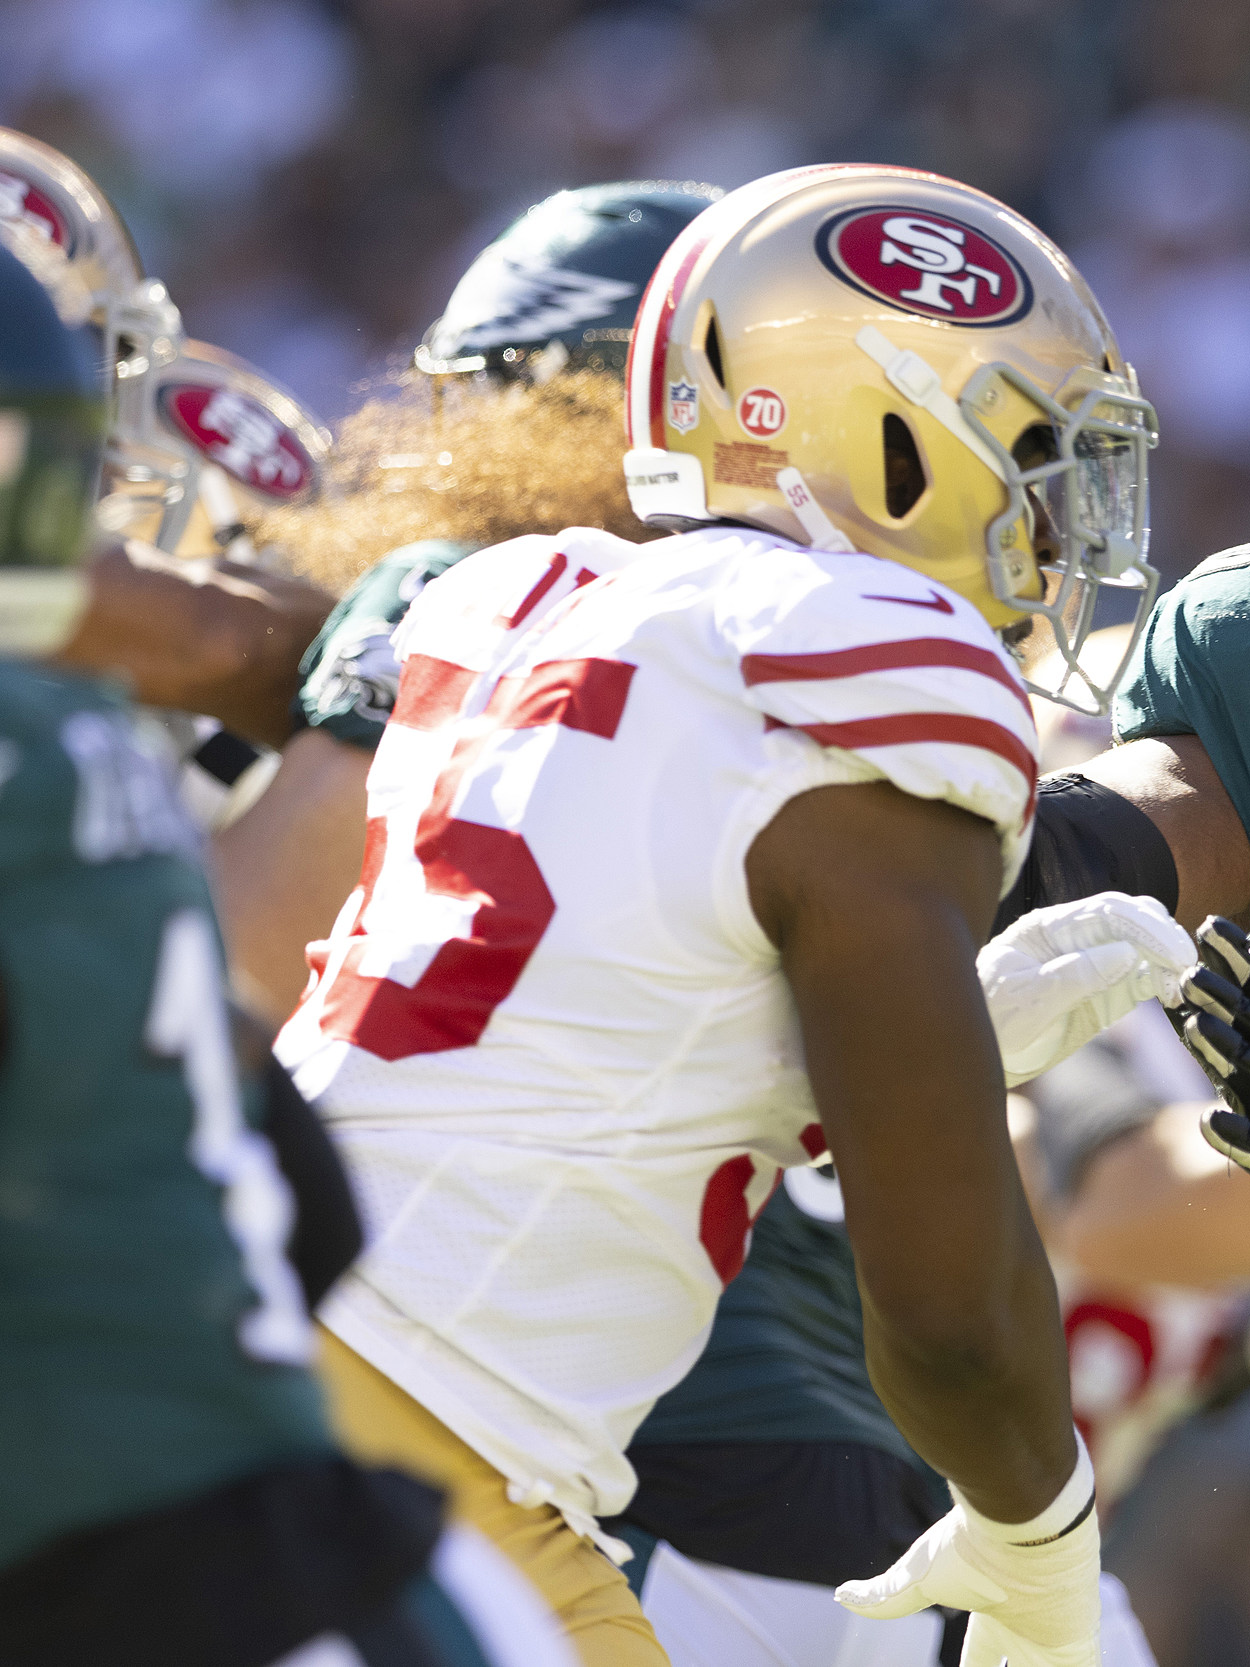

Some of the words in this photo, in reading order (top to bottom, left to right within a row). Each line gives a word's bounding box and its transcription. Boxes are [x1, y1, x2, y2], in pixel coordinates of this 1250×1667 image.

[880, 217, 1000, 311] SF
[746, 395, 781, 429] 70
[787, 484, 809, 508] 55
